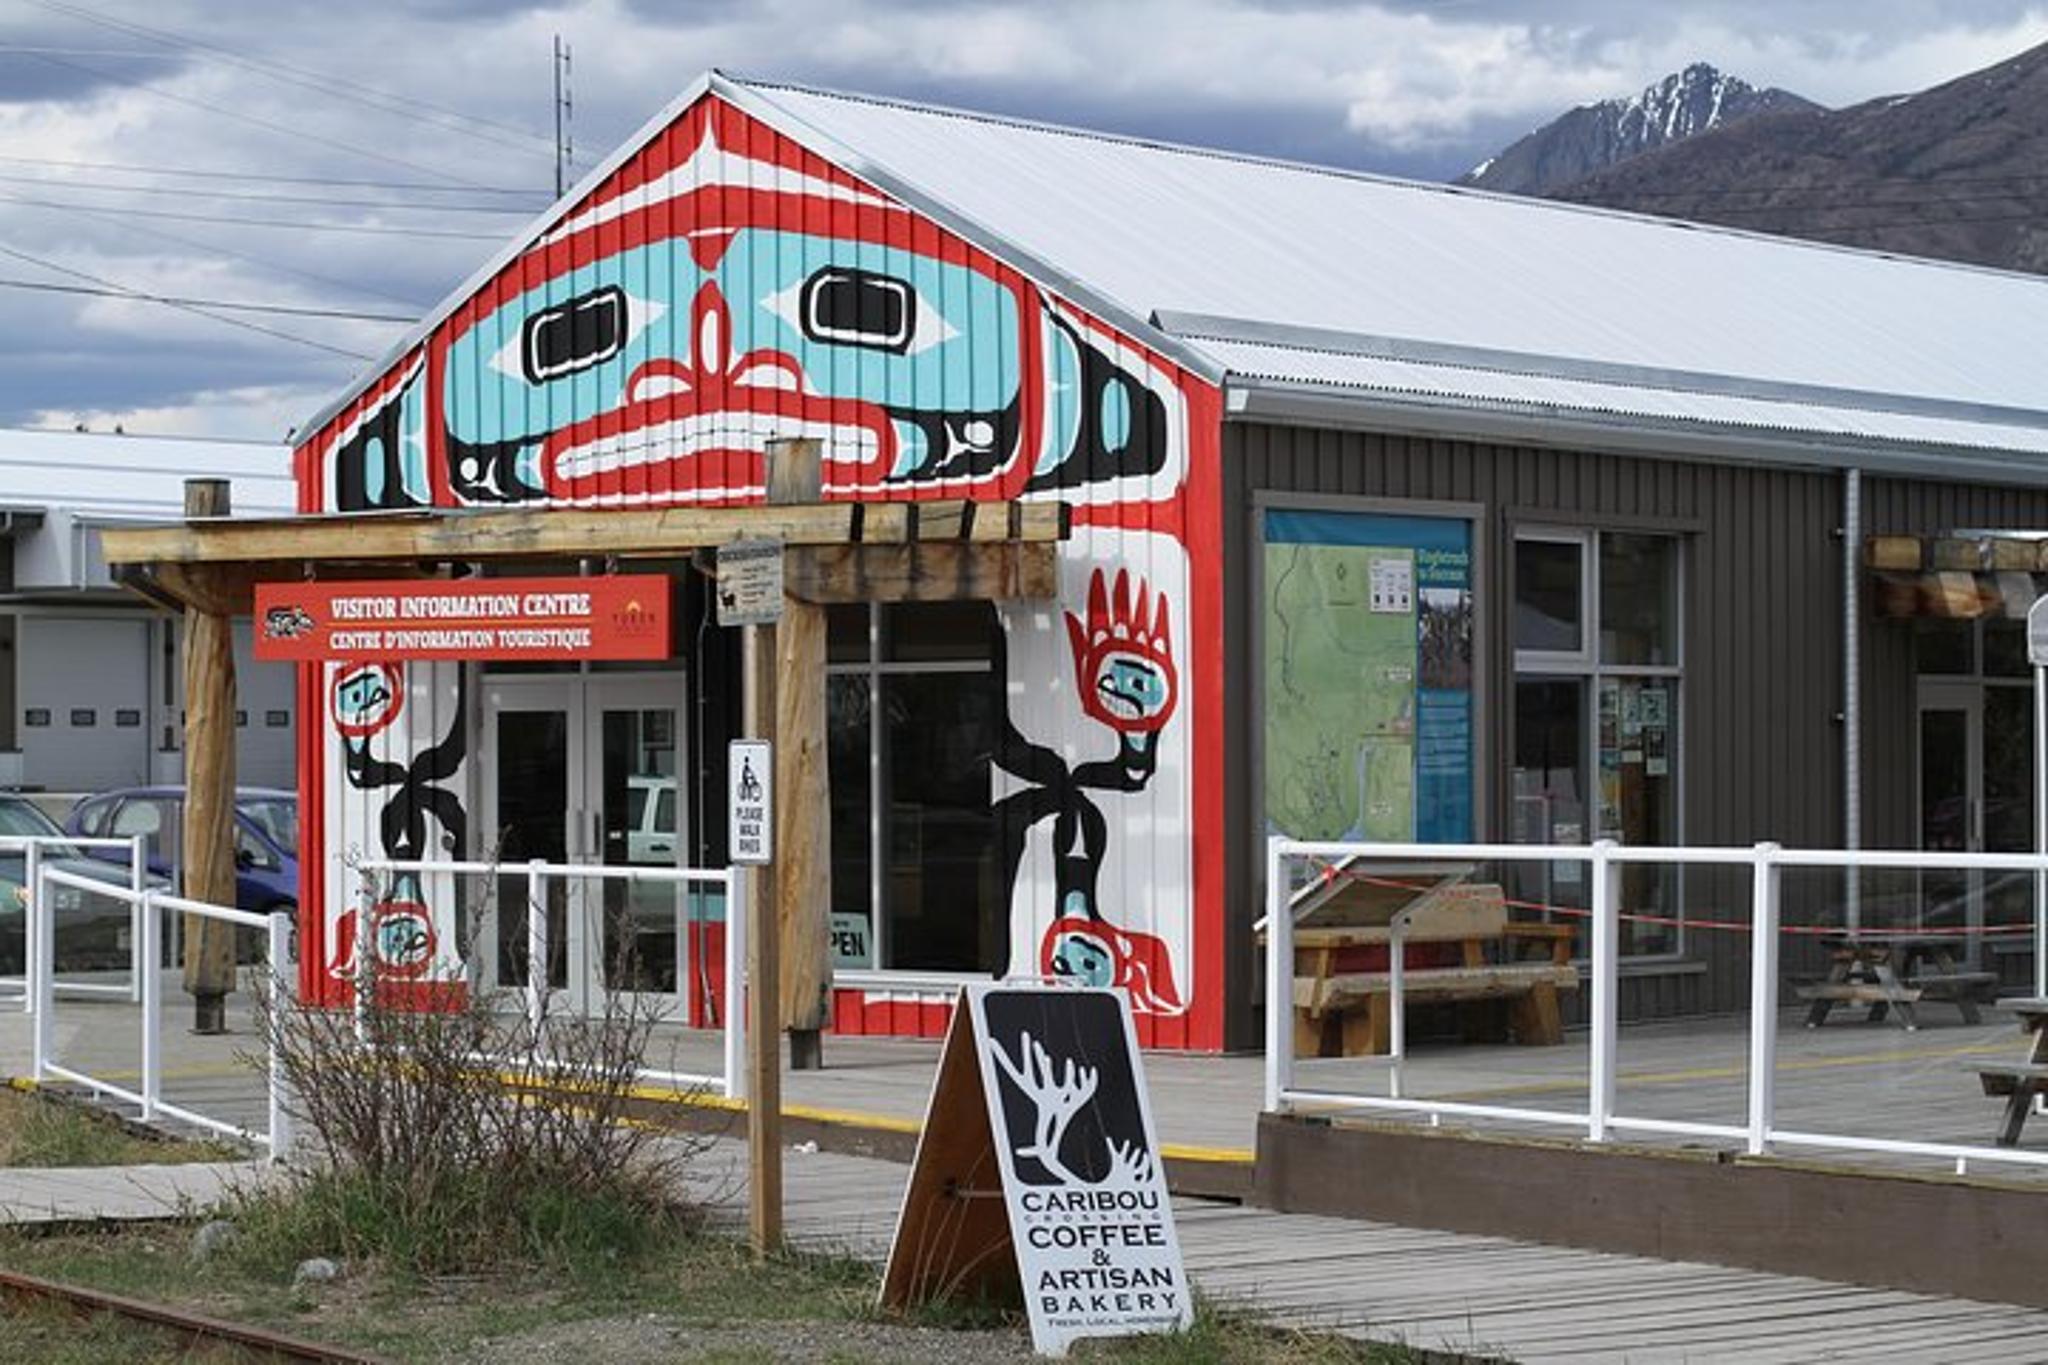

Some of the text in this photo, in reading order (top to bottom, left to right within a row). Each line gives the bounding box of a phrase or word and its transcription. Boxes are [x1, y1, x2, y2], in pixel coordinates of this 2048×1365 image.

[330, 593, 591, 619] VISITOR INFORMATION CENTRE
[330, 631, 381, 649] CENTRE
[385, 630, 495, 649] D'INFORMATION
[499, 628, 592, 652] TOURISTIQUE
[736, 807, 764, 822] PLEASE
[739, 824, 761, 837] WALK
[831, 932, 866, 957] PEN
[1021, 1190, 1159, 1212] CARIBOU
[1028, 1224, 1167, 1249] COFFEE
[1091, 1247, 1112, 1267] &
[1038, 1267, 1174, 1291] ARTISAN
[1041, 1292, 1177, 1314] BAKERY
